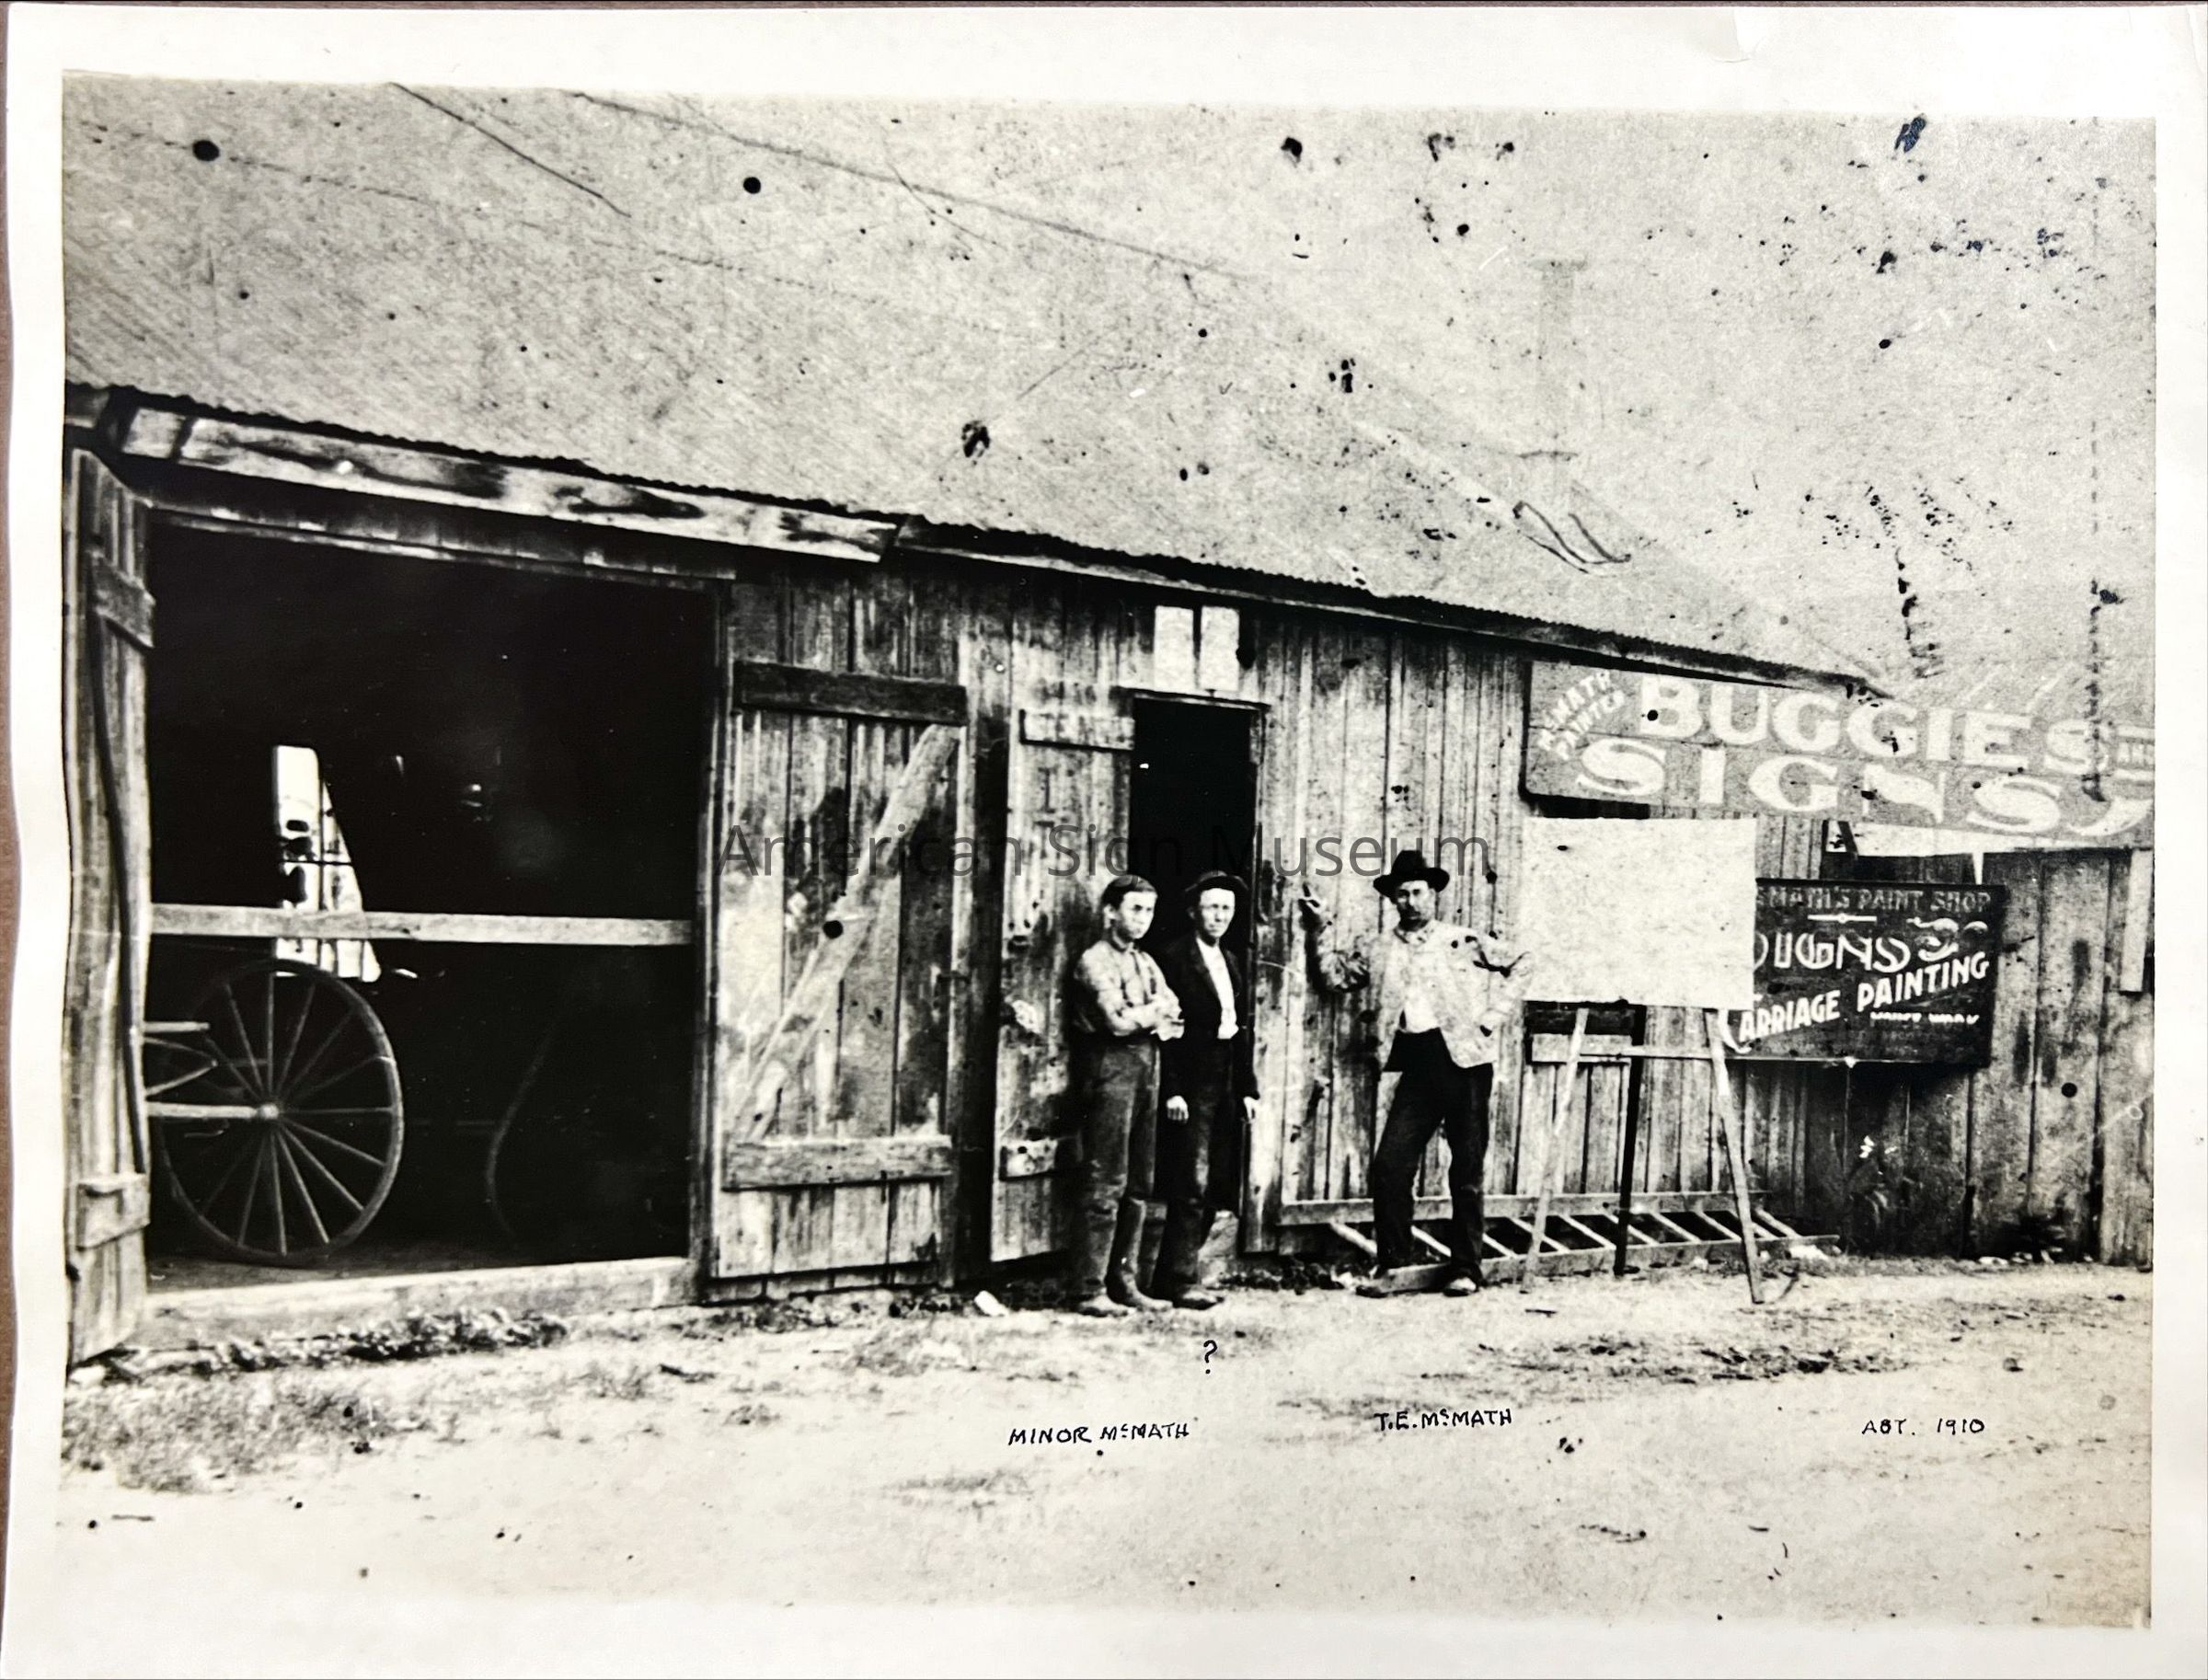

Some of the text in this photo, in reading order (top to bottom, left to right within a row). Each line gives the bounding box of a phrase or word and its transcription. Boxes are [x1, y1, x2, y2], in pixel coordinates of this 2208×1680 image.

[1639, 675, 2111, 777] BUGGIES
[1575, 738, 2062, 833] SIGNS
[1857, 889, 1924, 910] PAINT
[1930, 892, 1991, 913] SHOP
[1857, 951, 1990, 1013] PAINTING
[1203, 1340, 1218, 1375] ?
[1008, 1426, 1092, 1445] MINOR
[1937, 1418, 1985, 1435] 1910
